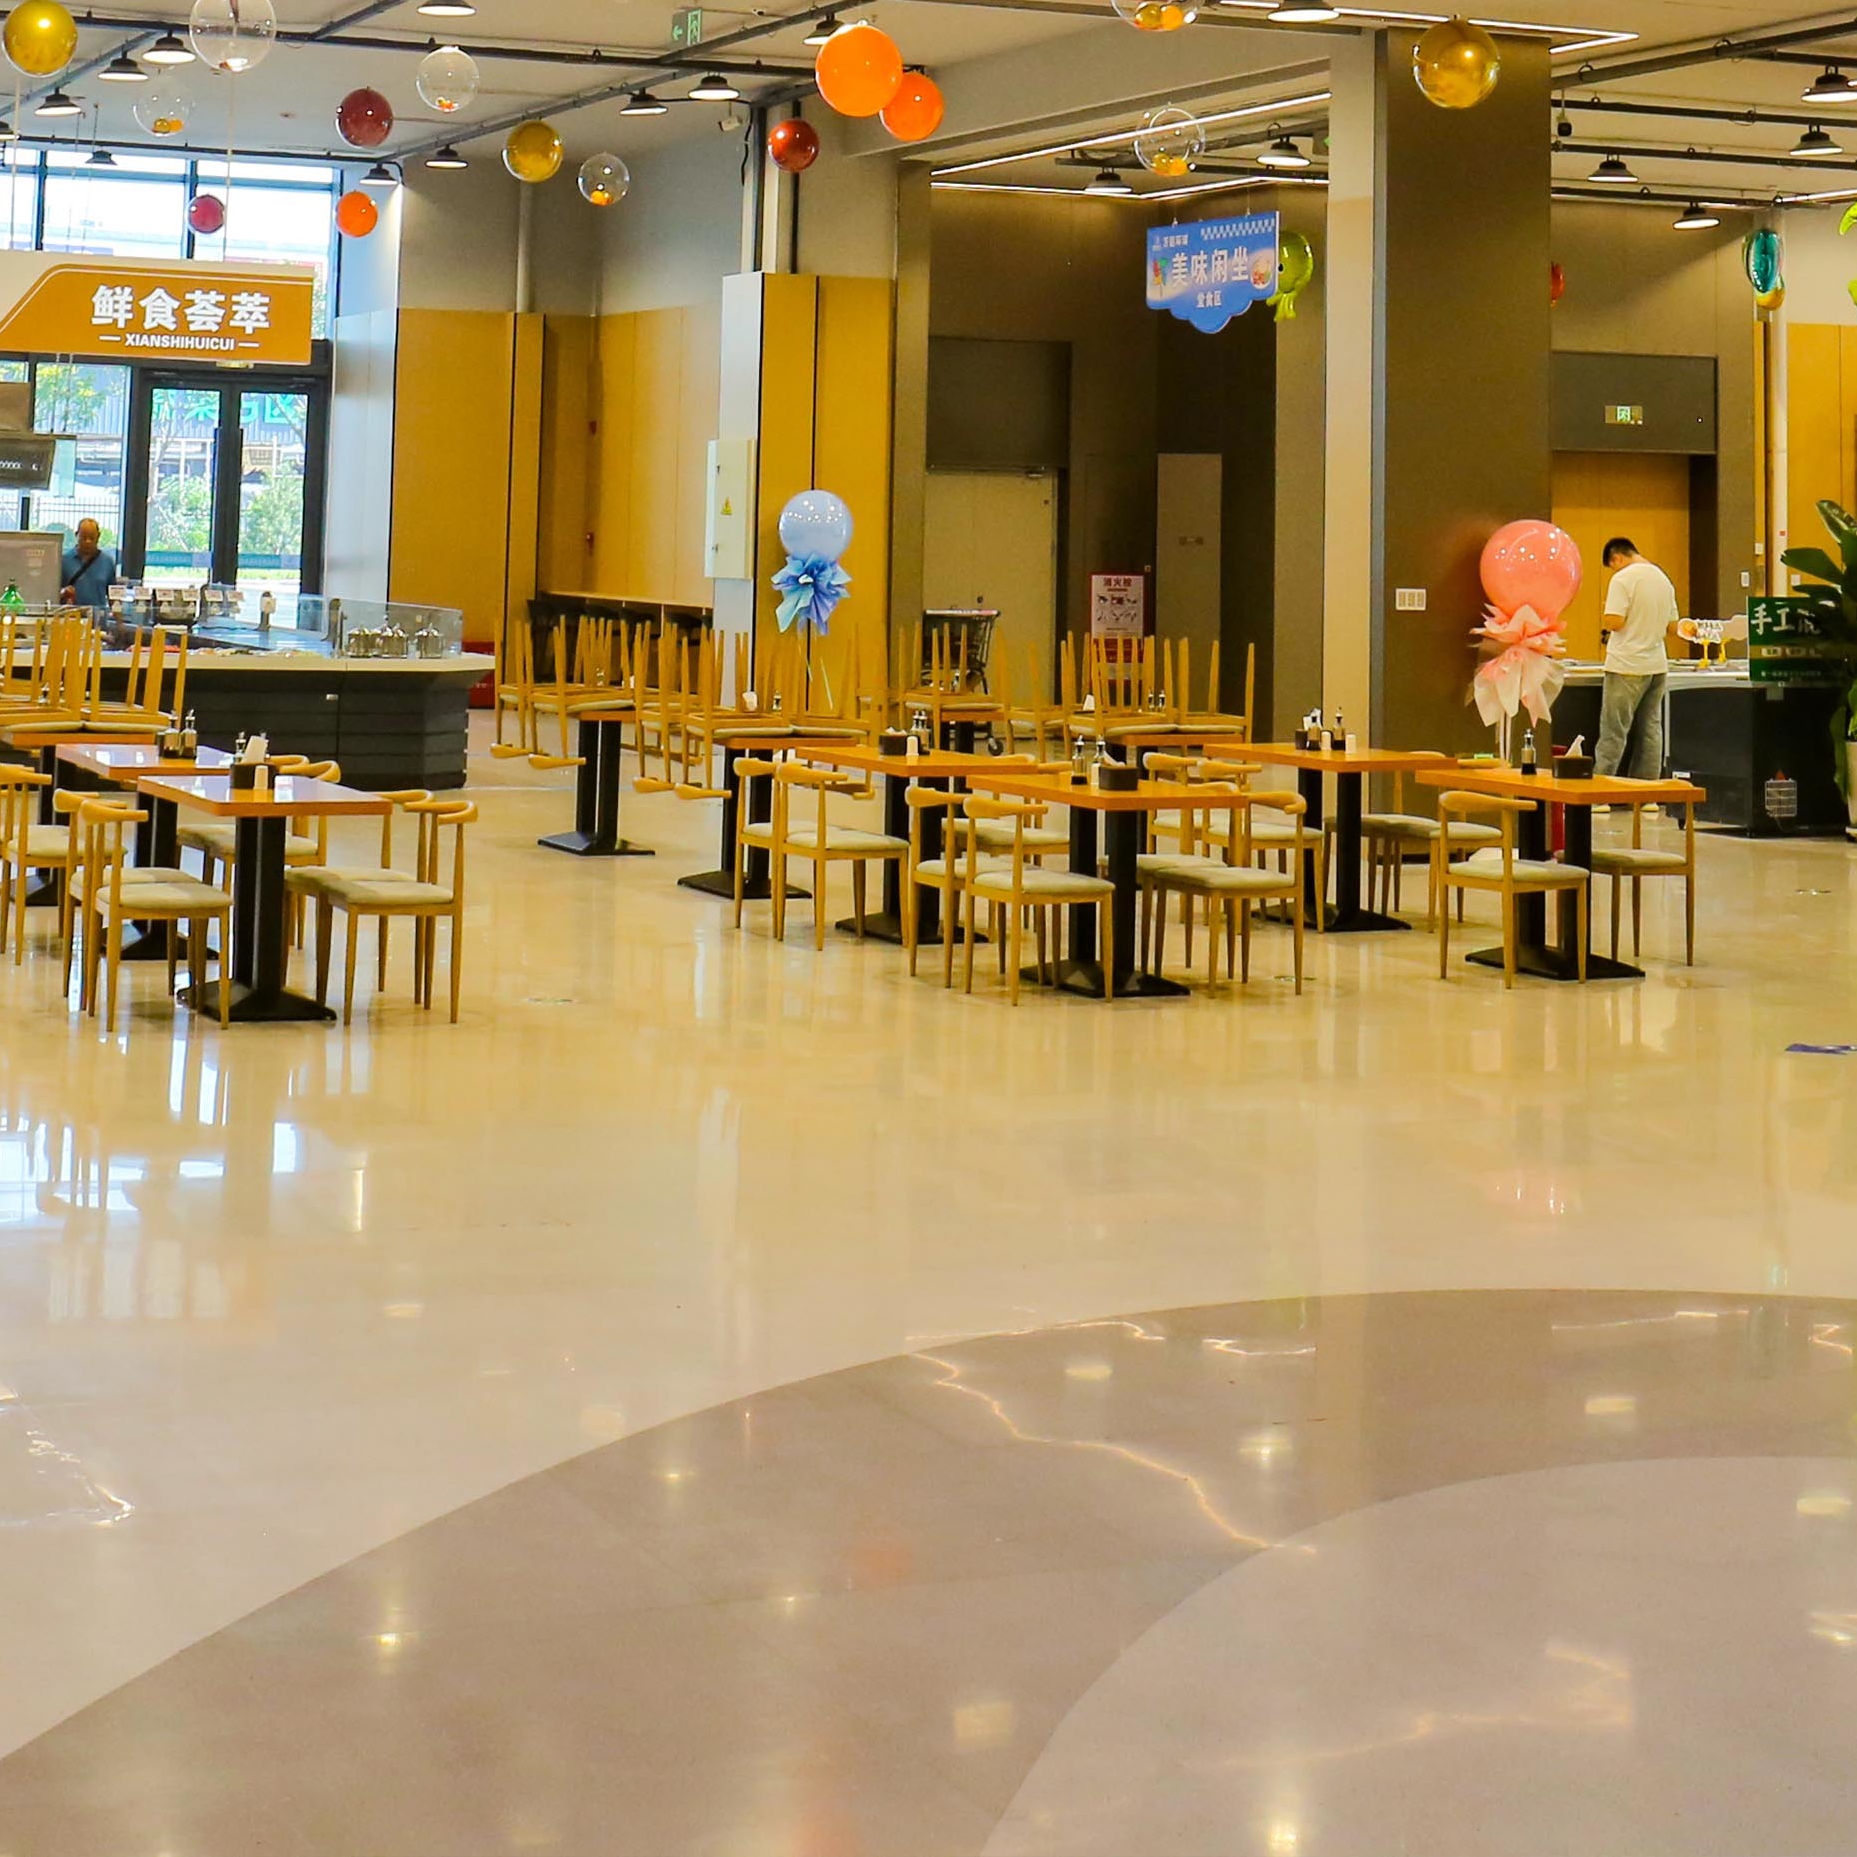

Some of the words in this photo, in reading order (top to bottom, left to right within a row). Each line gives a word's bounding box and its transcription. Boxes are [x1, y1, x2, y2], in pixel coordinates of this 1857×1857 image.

[91, 284, 271, 334] 鲜食荟萃
[123, 332, 236, 351] XIANSHIHUICUI
